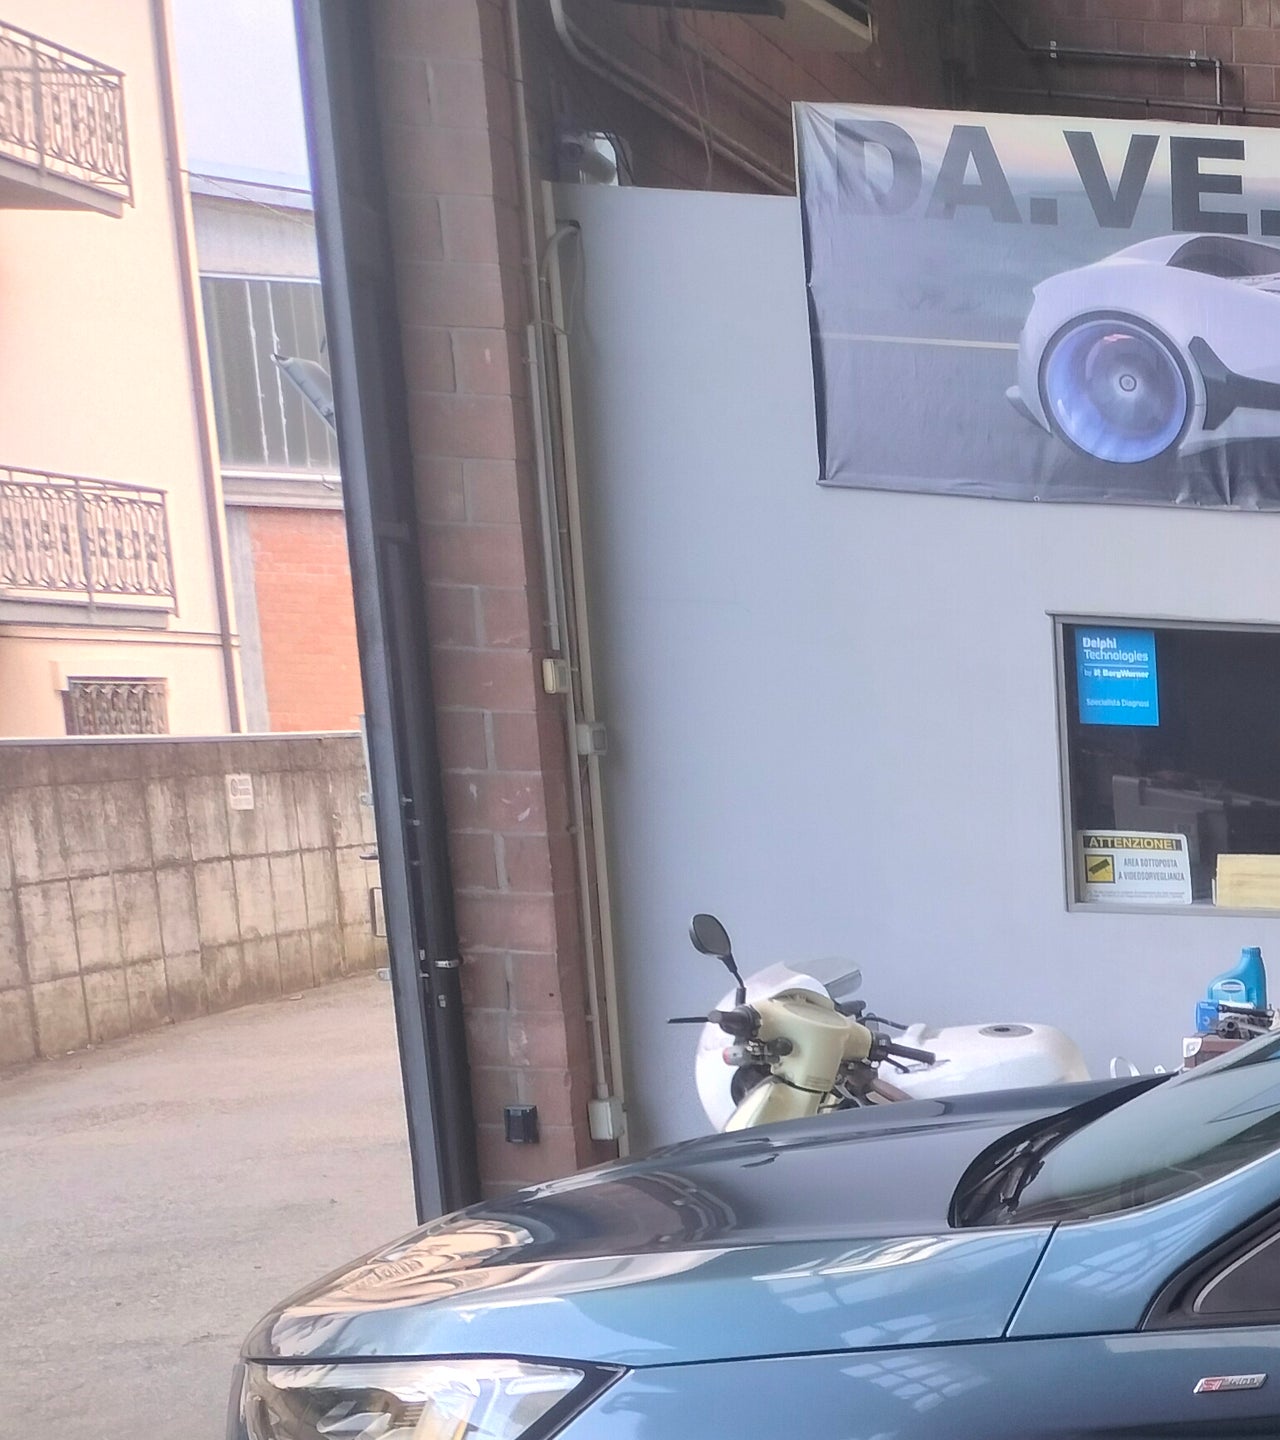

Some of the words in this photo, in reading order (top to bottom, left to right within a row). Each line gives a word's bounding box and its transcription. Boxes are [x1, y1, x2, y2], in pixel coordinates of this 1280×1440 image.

[1083, 637, 1117, 650] Delphi
[1083, 649, 1149, 663] Technologies
[1089, 836, 1177, 850] ATTENZIONE!
